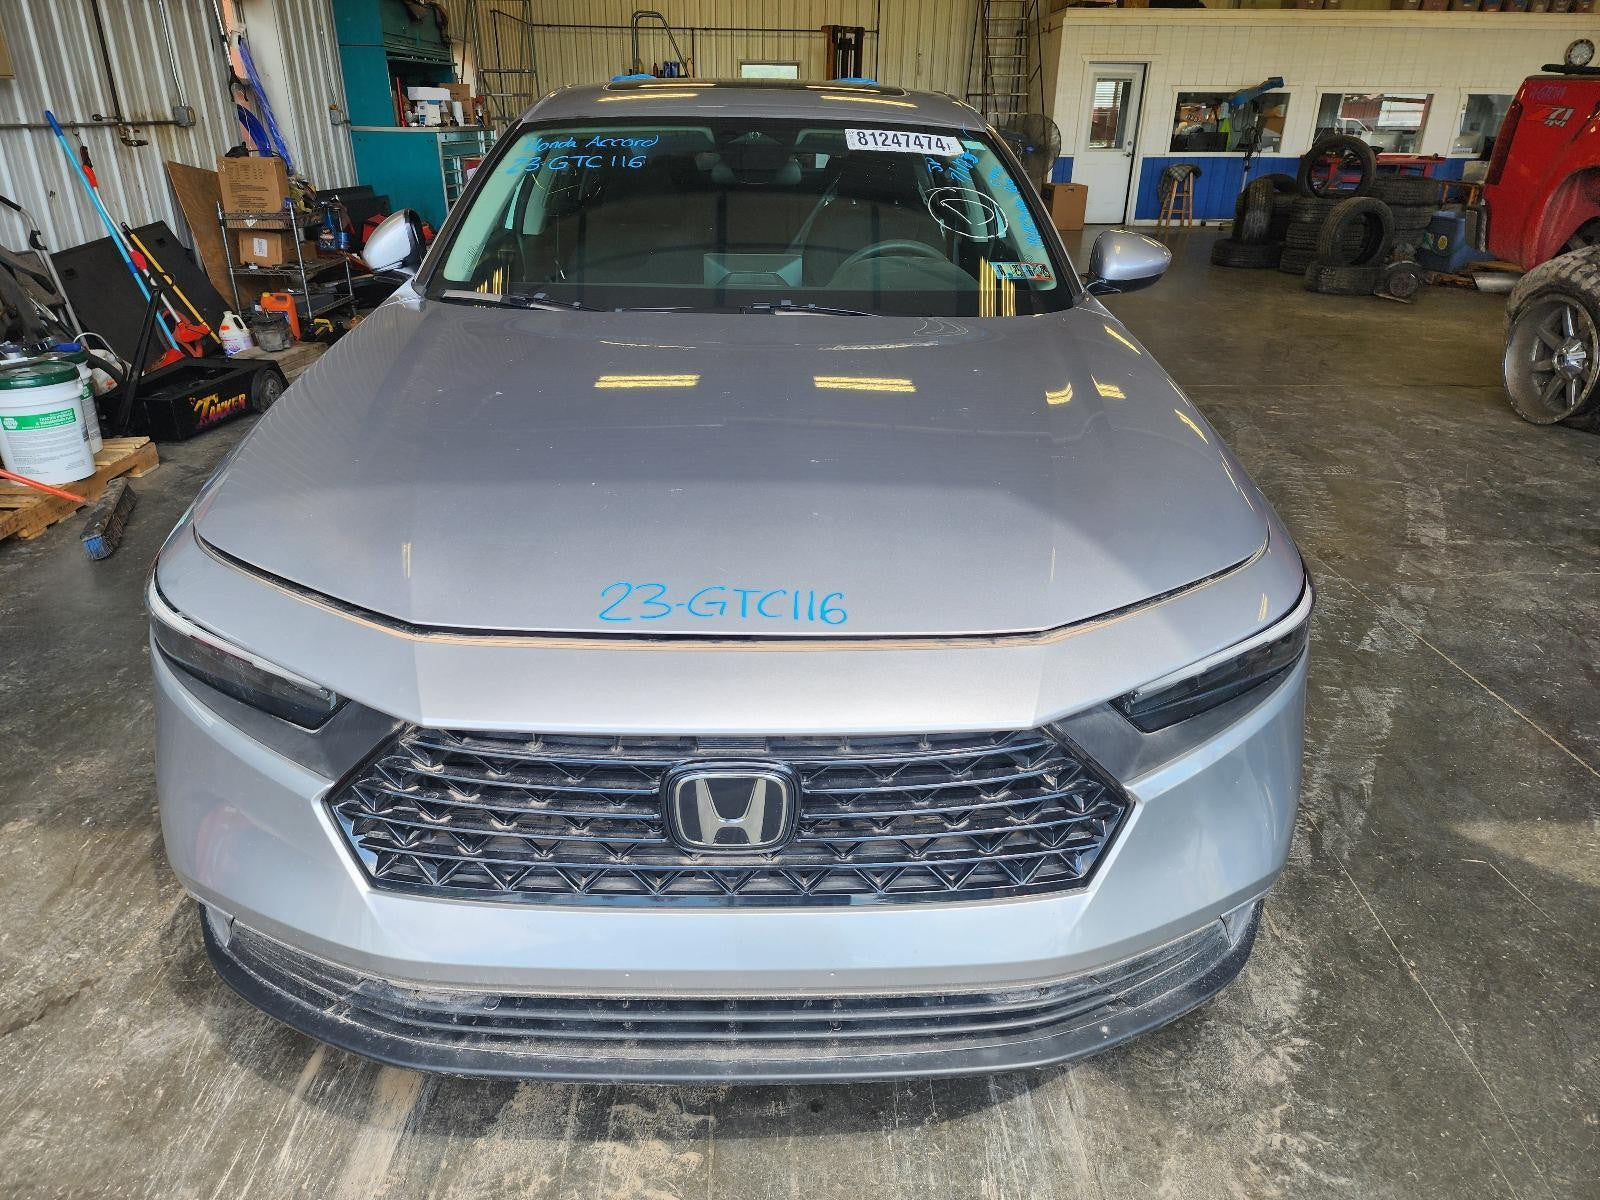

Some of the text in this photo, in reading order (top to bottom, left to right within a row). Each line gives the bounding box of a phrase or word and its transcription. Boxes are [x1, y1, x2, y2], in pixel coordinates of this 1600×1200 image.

[585, 134, 660, 149] Accord
[856, 130, 946, 152] 81247474
[598, 581, 848, 625] 23-GTC116
